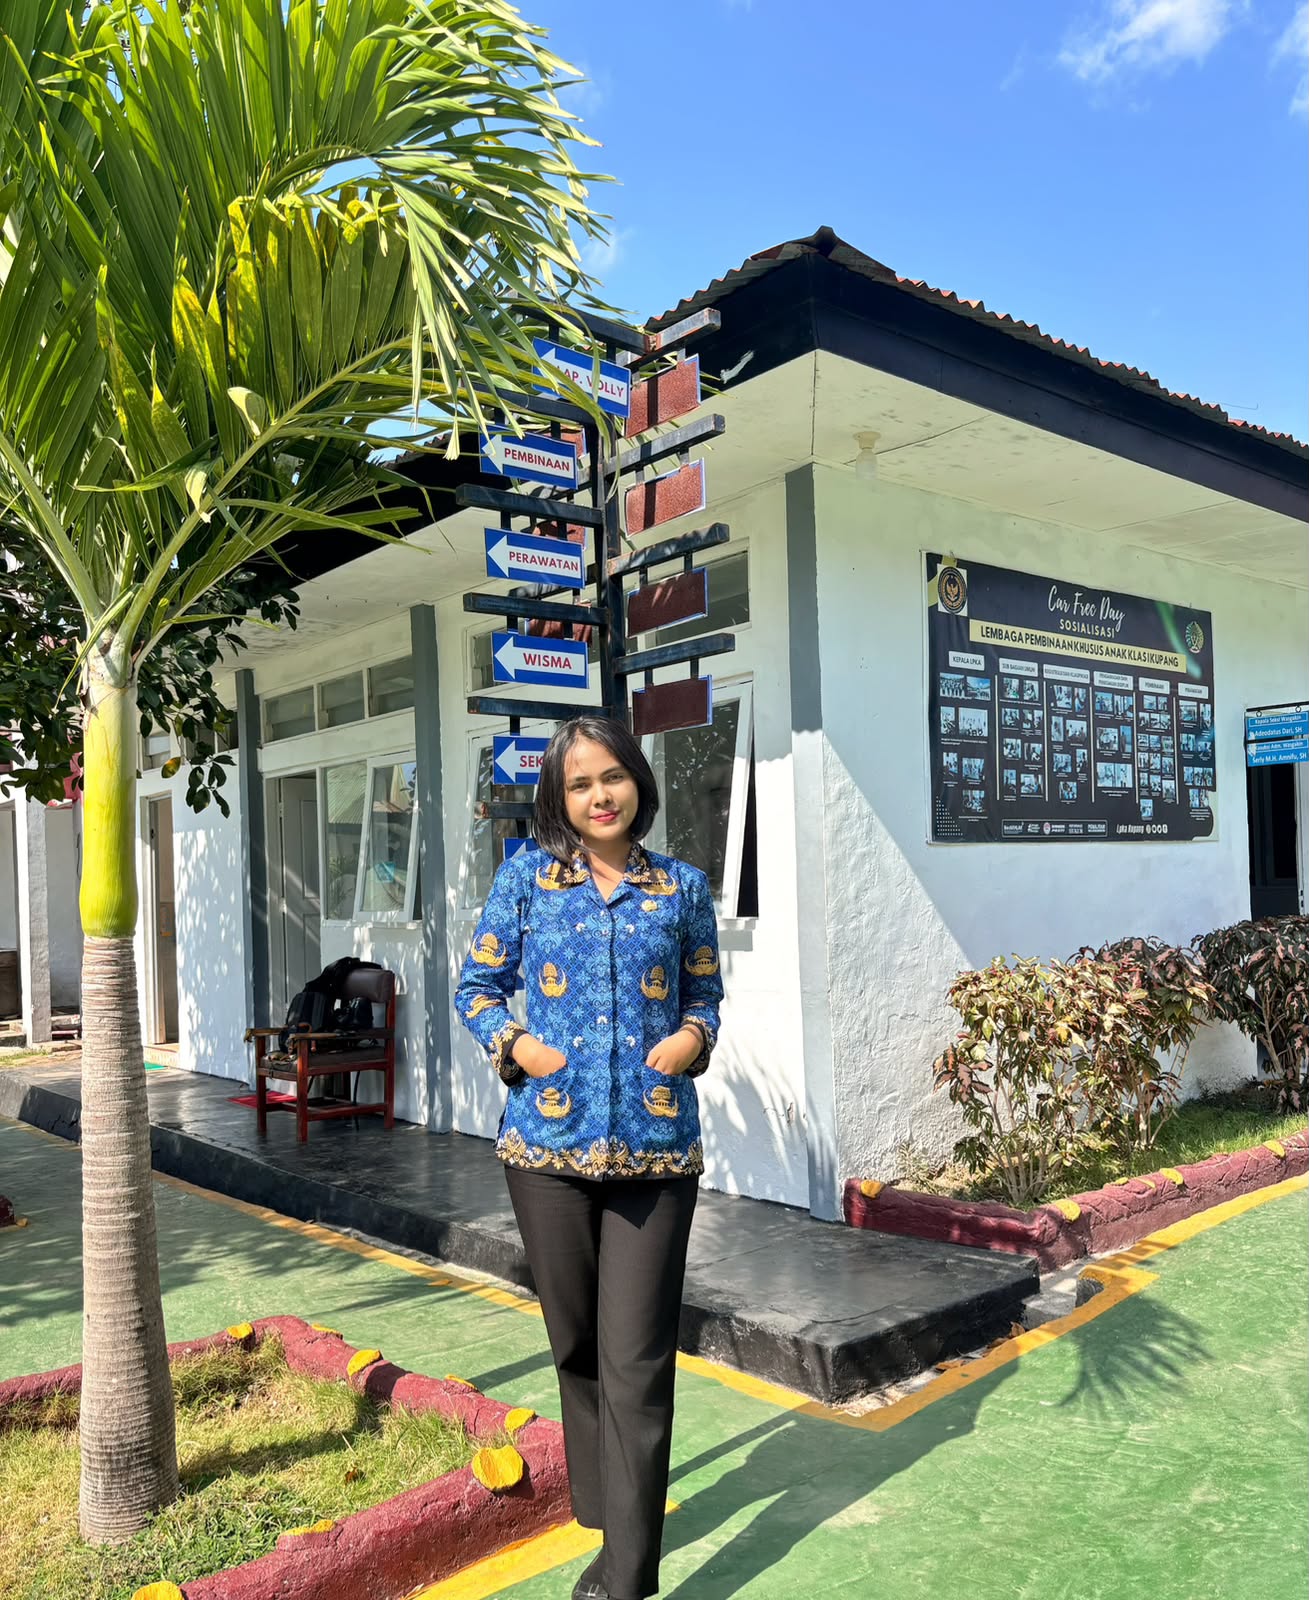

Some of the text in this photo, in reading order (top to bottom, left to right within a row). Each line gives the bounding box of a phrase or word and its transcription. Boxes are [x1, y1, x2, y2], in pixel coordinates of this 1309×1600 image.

[557, 365, 582, 384] AP.
[504, 448, 570, 472] PEMBINAAN
[509, 551, 579, 572] PERAWATAN
[1048, 585, 1070, 612] Car
[1099, 597, 1125, 632] Day
[1060, 619, 1115, 638] SOSIALISASI
[981, 625, 1024, 643] LEMBAGA
[1025, 633, 1073, 651] PEMBINAAN
[1073, 641, 1103, 656] KHUSUS
[1105, 648, 1127, 660] ANAK
[1150, 654, 1179, 667] KUPANG
[523, 652, 572, 670] WISMA
